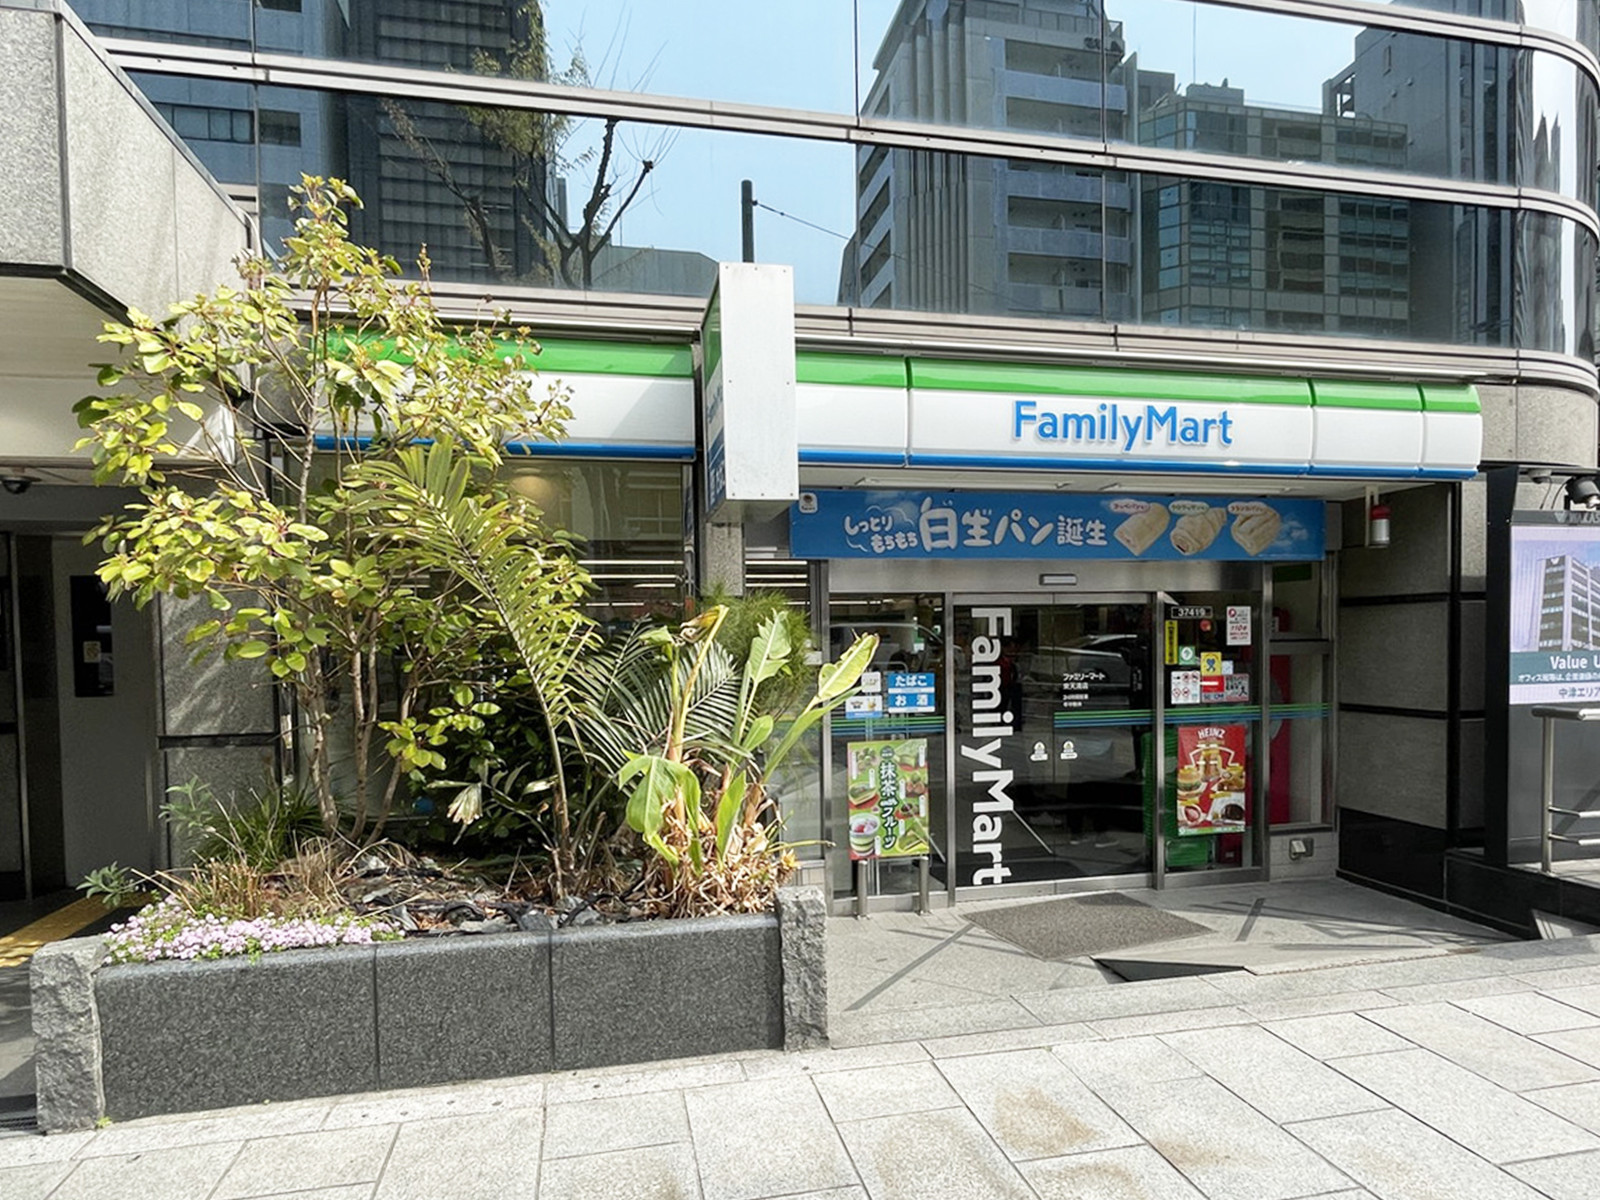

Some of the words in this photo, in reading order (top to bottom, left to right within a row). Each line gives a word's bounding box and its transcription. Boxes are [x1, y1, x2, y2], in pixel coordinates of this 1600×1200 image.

[1014, 400, 1233, 452] FamilyMart
[844, 515, 893, 536] しっとり
[871, 531, 919, 554] もちもち
[1178, 607, 1206, 617] 37419
[1550, 654, 1588, 669] Value
[895, 675, 927, 687] たばこ
[1063, 672, 1106, 681] ファミリーマート
[1198, 727, 1226, 739] HEINZ
[961, 607, 1014, 886] FamilyMart
